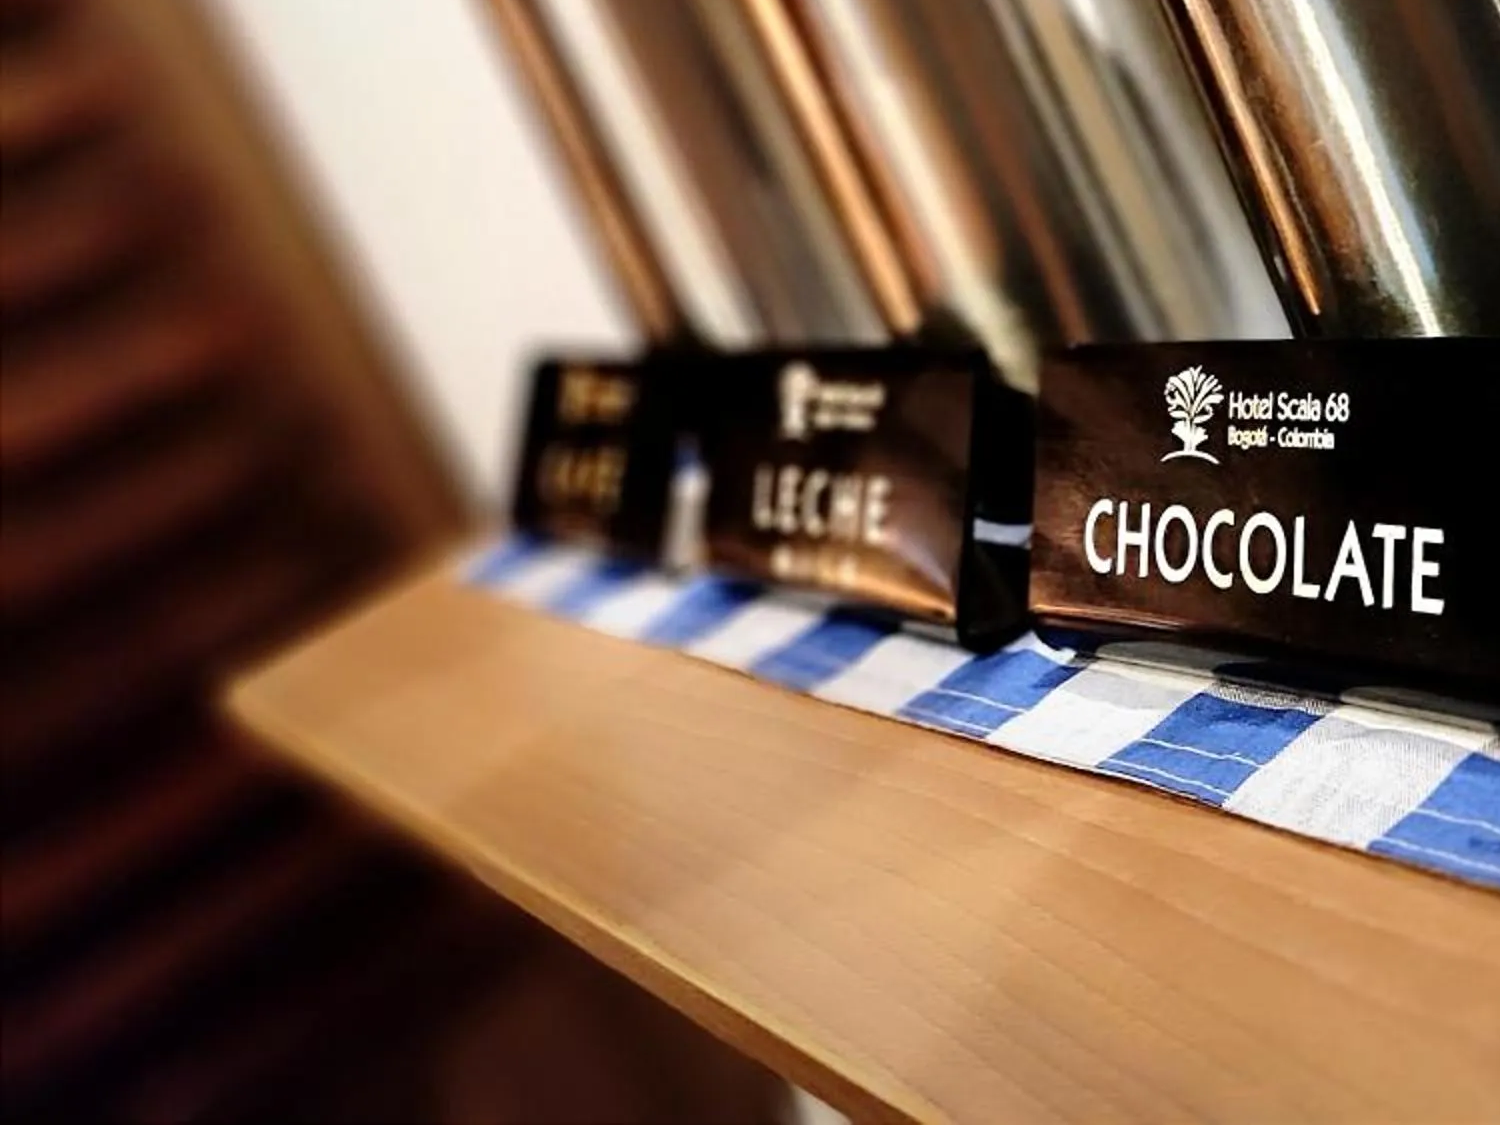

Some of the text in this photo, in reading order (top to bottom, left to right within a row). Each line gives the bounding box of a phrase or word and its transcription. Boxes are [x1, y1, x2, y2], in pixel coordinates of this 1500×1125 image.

[1228, 390, 1350, 422] Hotel Scala 68
[1277, 426, 1335, 449] Colombia
[753, 463, 892, 545] LECHE
[1084, 498, 1445, 615] CHOCOLATE
